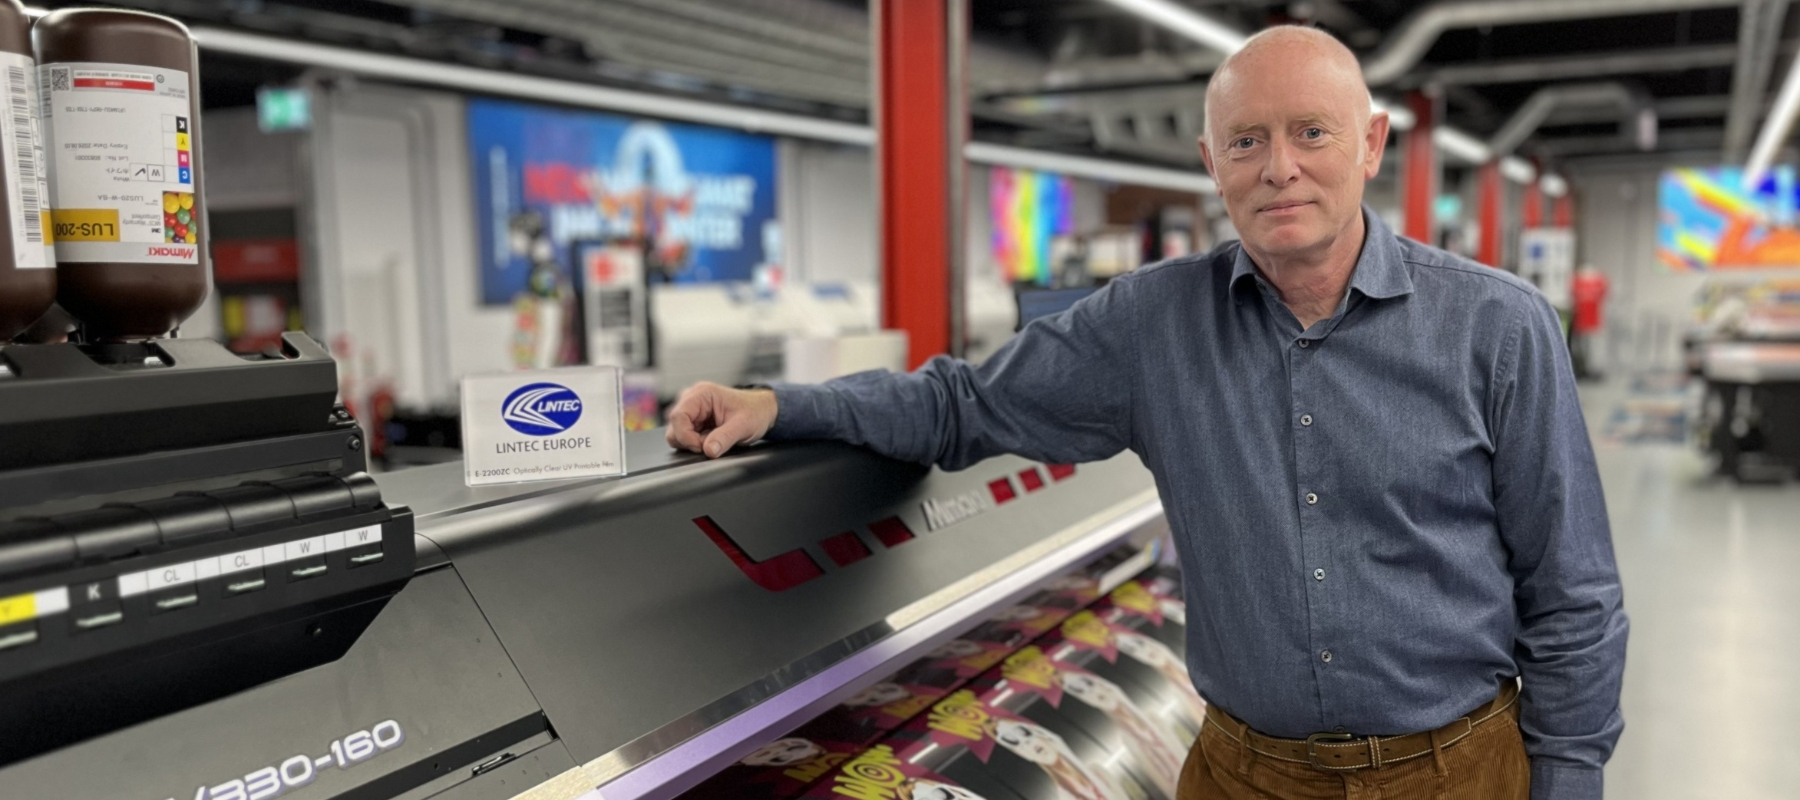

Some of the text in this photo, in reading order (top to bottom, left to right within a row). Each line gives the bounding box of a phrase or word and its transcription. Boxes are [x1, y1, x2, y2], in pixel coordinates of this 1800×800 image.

[179, 120, 186, 129] K
[55, 223, 114, 236] LUS-200
[537, 399, 580, 413] LINTEC
[496, 437, 592, 453] LINTEC EUROPE
[475, 468, 511, 477] E-2200ZC
[513, 466, 543, 475] Optically
[544, 464, 562, 472] Clear
[563, 463, 573, 471] UV
[574, 460, 601, 469] Printable
[359, 531, 369, 542] W
[300, 542, 311, 553] W
[234, 555, 250, 568] CL
[163, 569, 180, 582] CL
[88, 584, 100, 599] K
